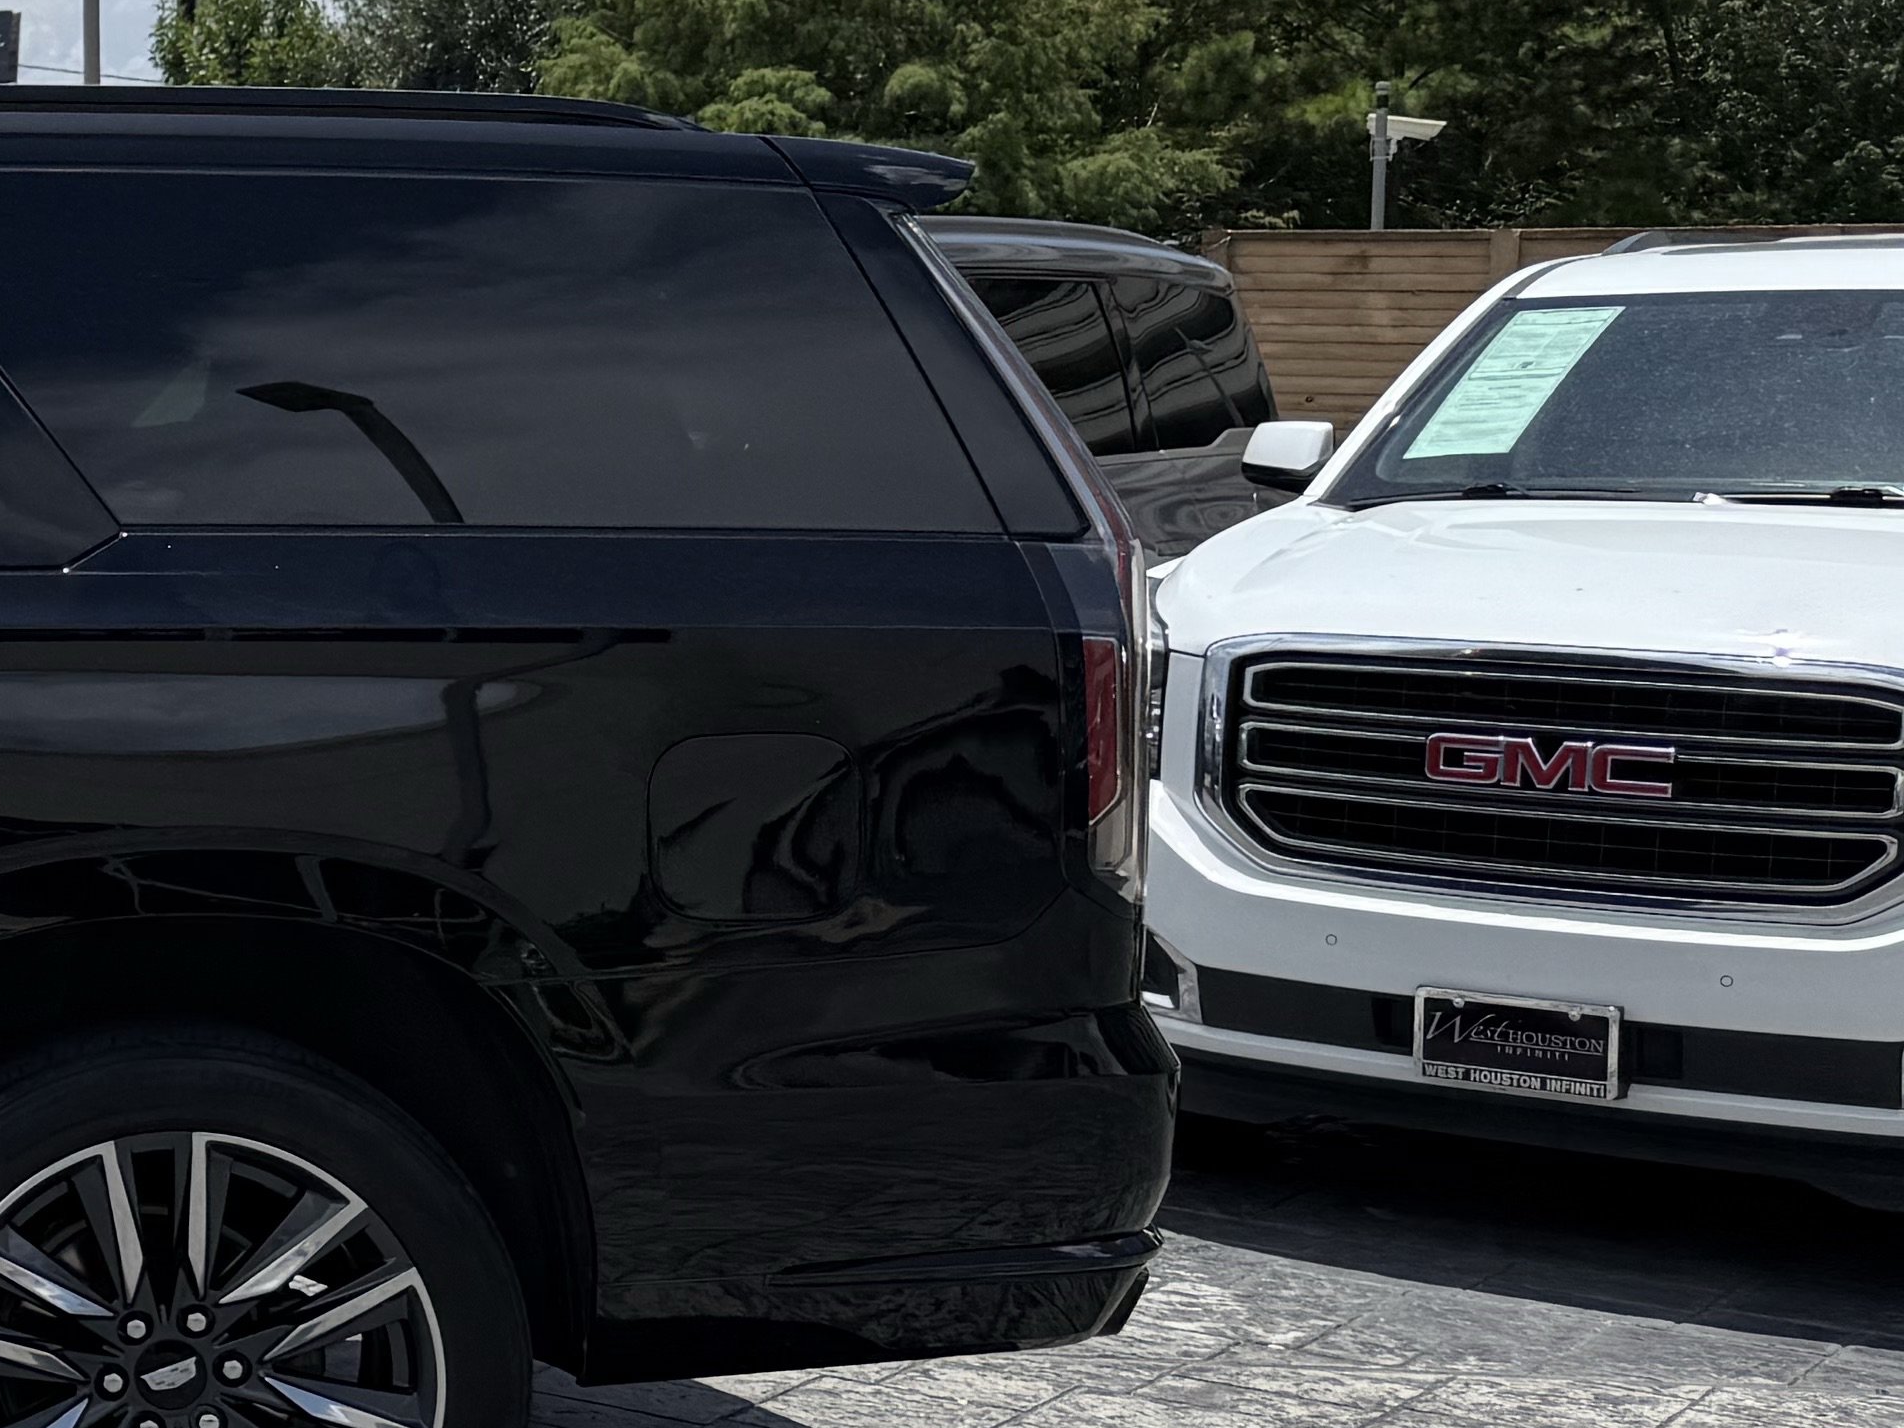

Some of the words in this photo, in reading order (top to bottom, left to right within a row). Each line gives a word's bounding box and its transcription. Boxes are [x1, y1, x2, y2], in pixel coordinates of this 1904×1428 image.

[1425, 733, 1675, 798] GMC
[1425, 1011, 1509, 1043] West
[1509, 1030, 1605, 1053] HOUSTON
[1497, 1045, 1569, 1061] INFINITI
[1424, 1063, 1466, 1080] WEST
[1470, 1069, 1541, 1090] HOUSTON
[1546, 1079, 1605, 1098] INFINITI
